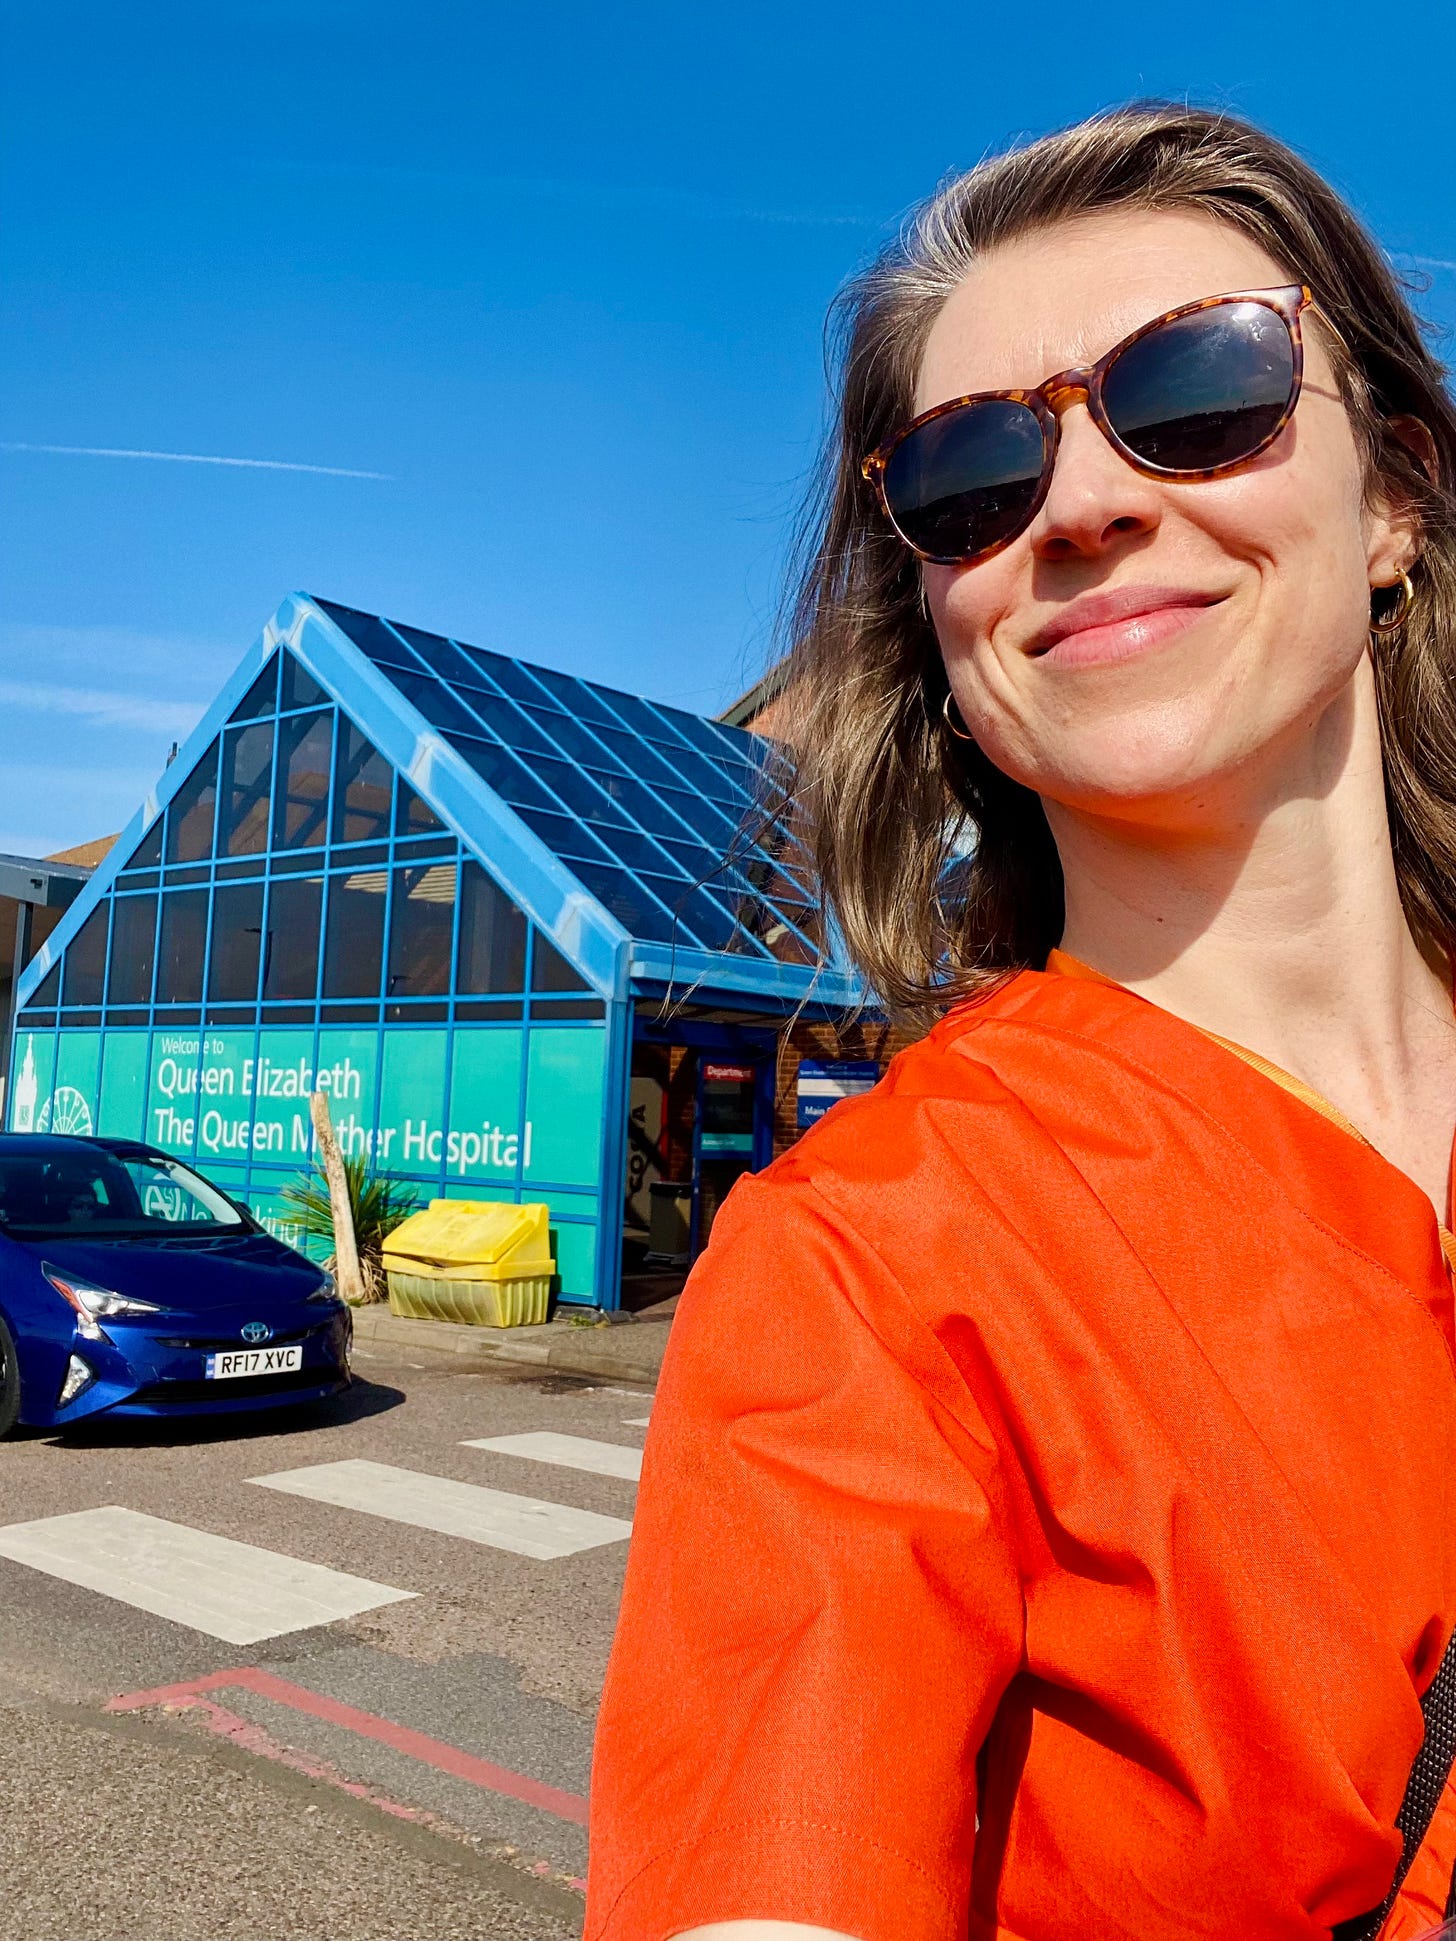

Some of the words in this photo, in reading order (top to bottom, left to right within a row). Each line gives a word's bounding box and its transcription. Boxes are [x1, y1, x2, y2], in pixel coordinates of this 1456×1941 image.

[161, 1037, 209, 1055] Welcome
[212, 1038, 224, 1055] to
[158, 1058, 234, 1099] Queen
[242, 1057, 361, 1099] Elizabeth
[805, 1106, 825, 1116] Main
[154, 1107, 194, 1146] The
[202, 1110, 283, 1152] Queen
[292, 1114, 396, 1158] Mther
[403, 1119, 532, 1175] Hospital
[254, 1205, 300, 1250] king
[221, 1353, 260, 1374] RF17
[265, 1350, 295, 1370] XVC
